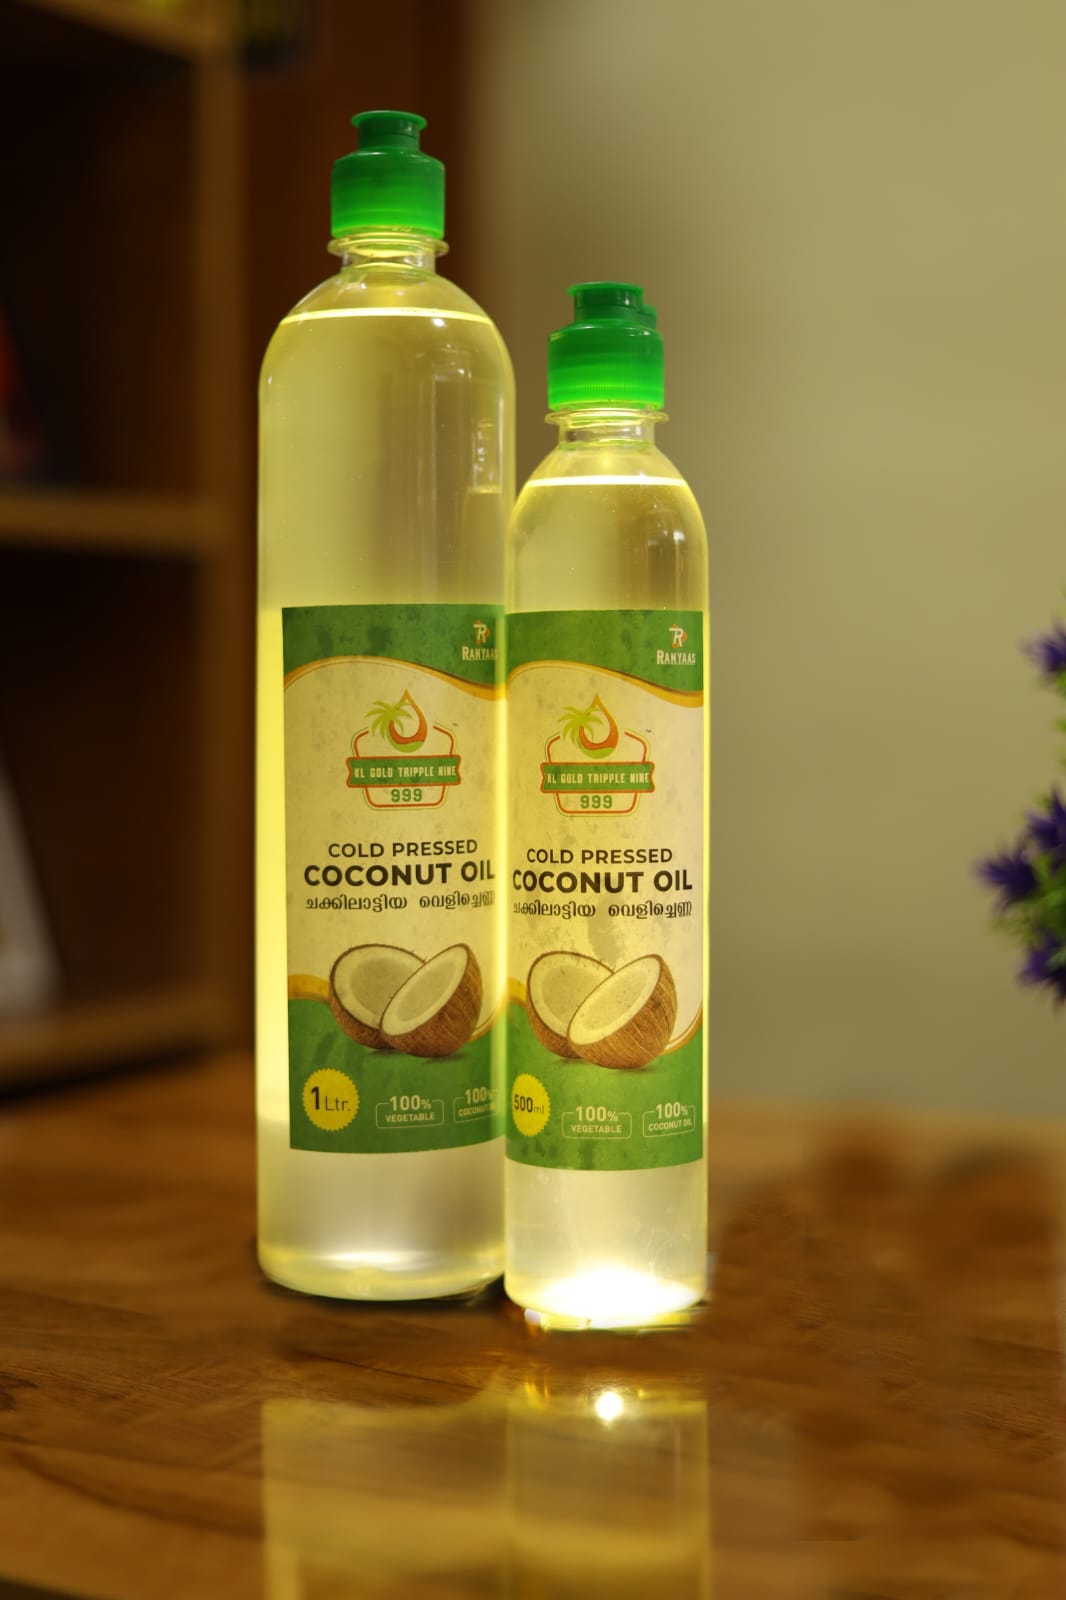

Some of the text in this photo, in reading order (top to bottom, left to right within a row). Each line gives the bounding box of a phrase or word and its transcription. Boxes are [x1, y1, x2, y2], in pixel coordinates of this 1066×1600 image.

[656, 650, 696, 665] RANYAAS
[370, 767, 394, 778] GOLD
[398, 766, 435, 777] TRIPPLE
[438, 765, 457, 776] NINE
[560, 773, 583, 784] GOLD
[587, 773, 626, 784] TRIPPLE
[629, 772, 650, 784] NINE
[391, 788, 423, 803] 999
[580, 795, 613, 809] 999
[328, 839, 478, 858] COLD PRESSED
[526, 848, 673, 865] COLD PRESSED
[304, 859, 496, 887] COCONUT OIL
[512, 869, 693, 894] COCONUT OIL
[310, 1086, 352, 1112] 1 Ltr.
[390, 1095, 433, 1111] 100%
[385, 1112, 436, 1123] VEGETABLE
[575, 1106, 620, 1123] 100%
[655, 1101, 690, 1119] 100%
[570, 1124, 623, 1134] VEGETABLE
[648, 1119, 693, 1132] COCONUT OIL
